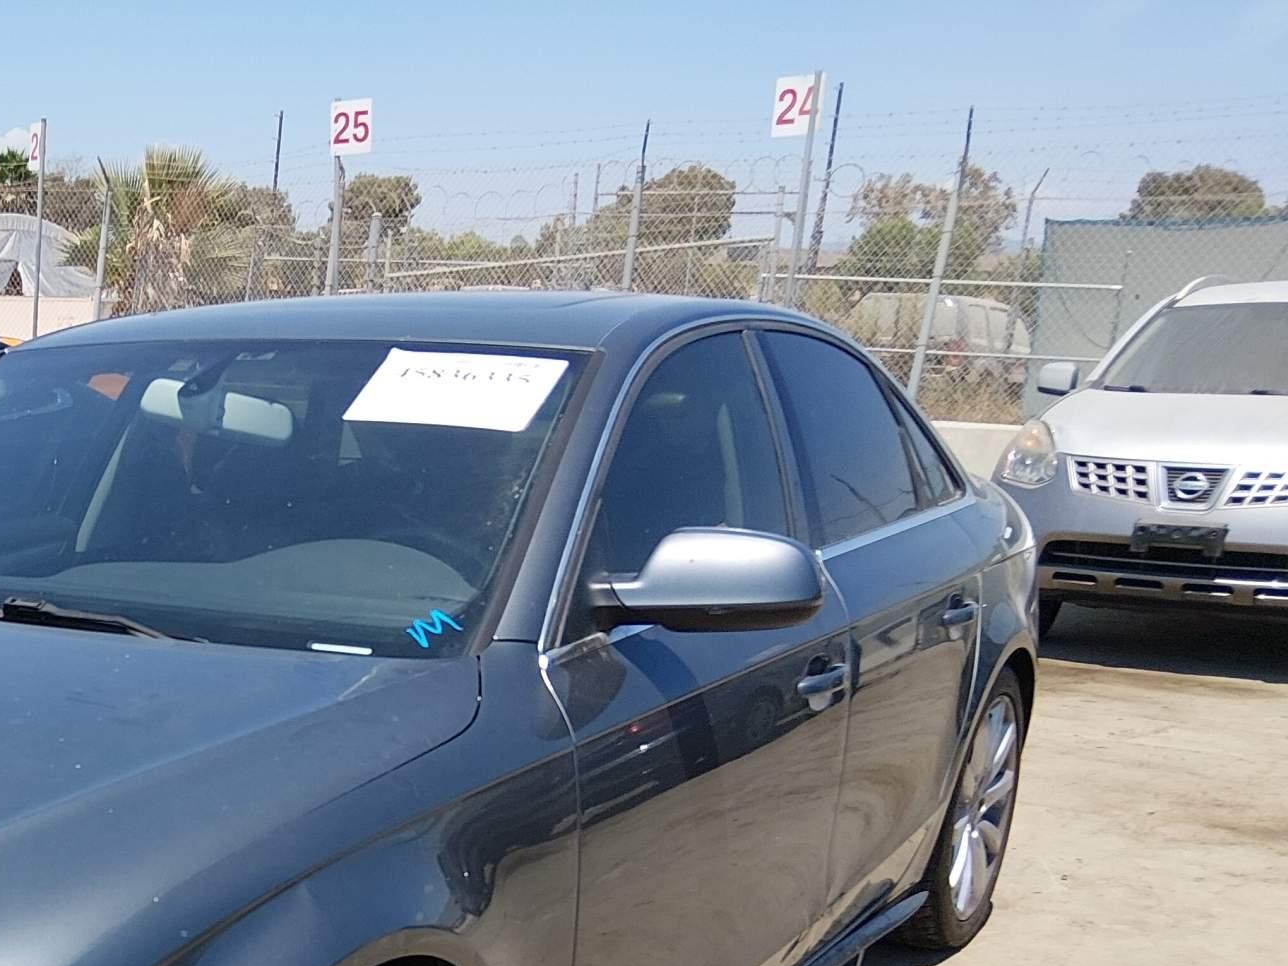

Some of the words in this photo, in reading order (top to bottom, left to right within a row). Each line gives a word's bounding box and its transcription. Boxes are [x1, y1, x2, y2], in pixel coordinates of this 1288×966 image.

[775, 86, 819, 126] 24
[333, 110, 369, 144] 25
[30, 132, 39, 161] 2
